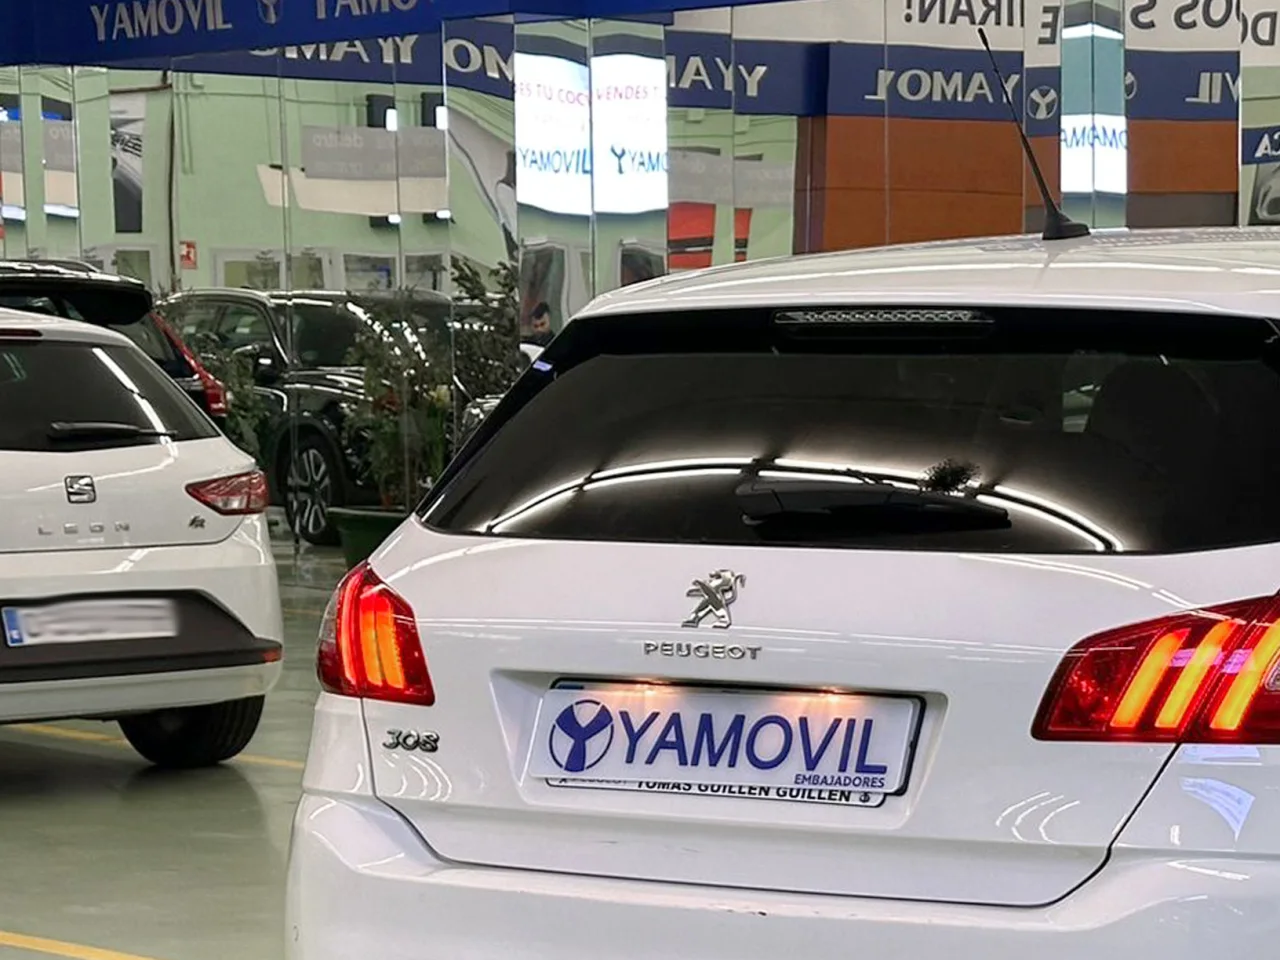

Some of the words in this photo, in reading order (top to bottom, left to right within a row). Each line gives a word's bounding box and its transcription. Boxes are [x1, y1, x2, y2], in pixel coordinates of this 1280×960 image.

[89, 0, 233, 42] YAMOVIL
[518, 148, 592, 174] YAMOVIL
[643, 641, 763, 661] PEUGEOT
[382, 729, 441, 754] 308
[618, 709, 888, 775] YAMOVIL
[793, 774, 886, 789] EMBAJADORES
[776, 787, 851, 802] GUILLEN
